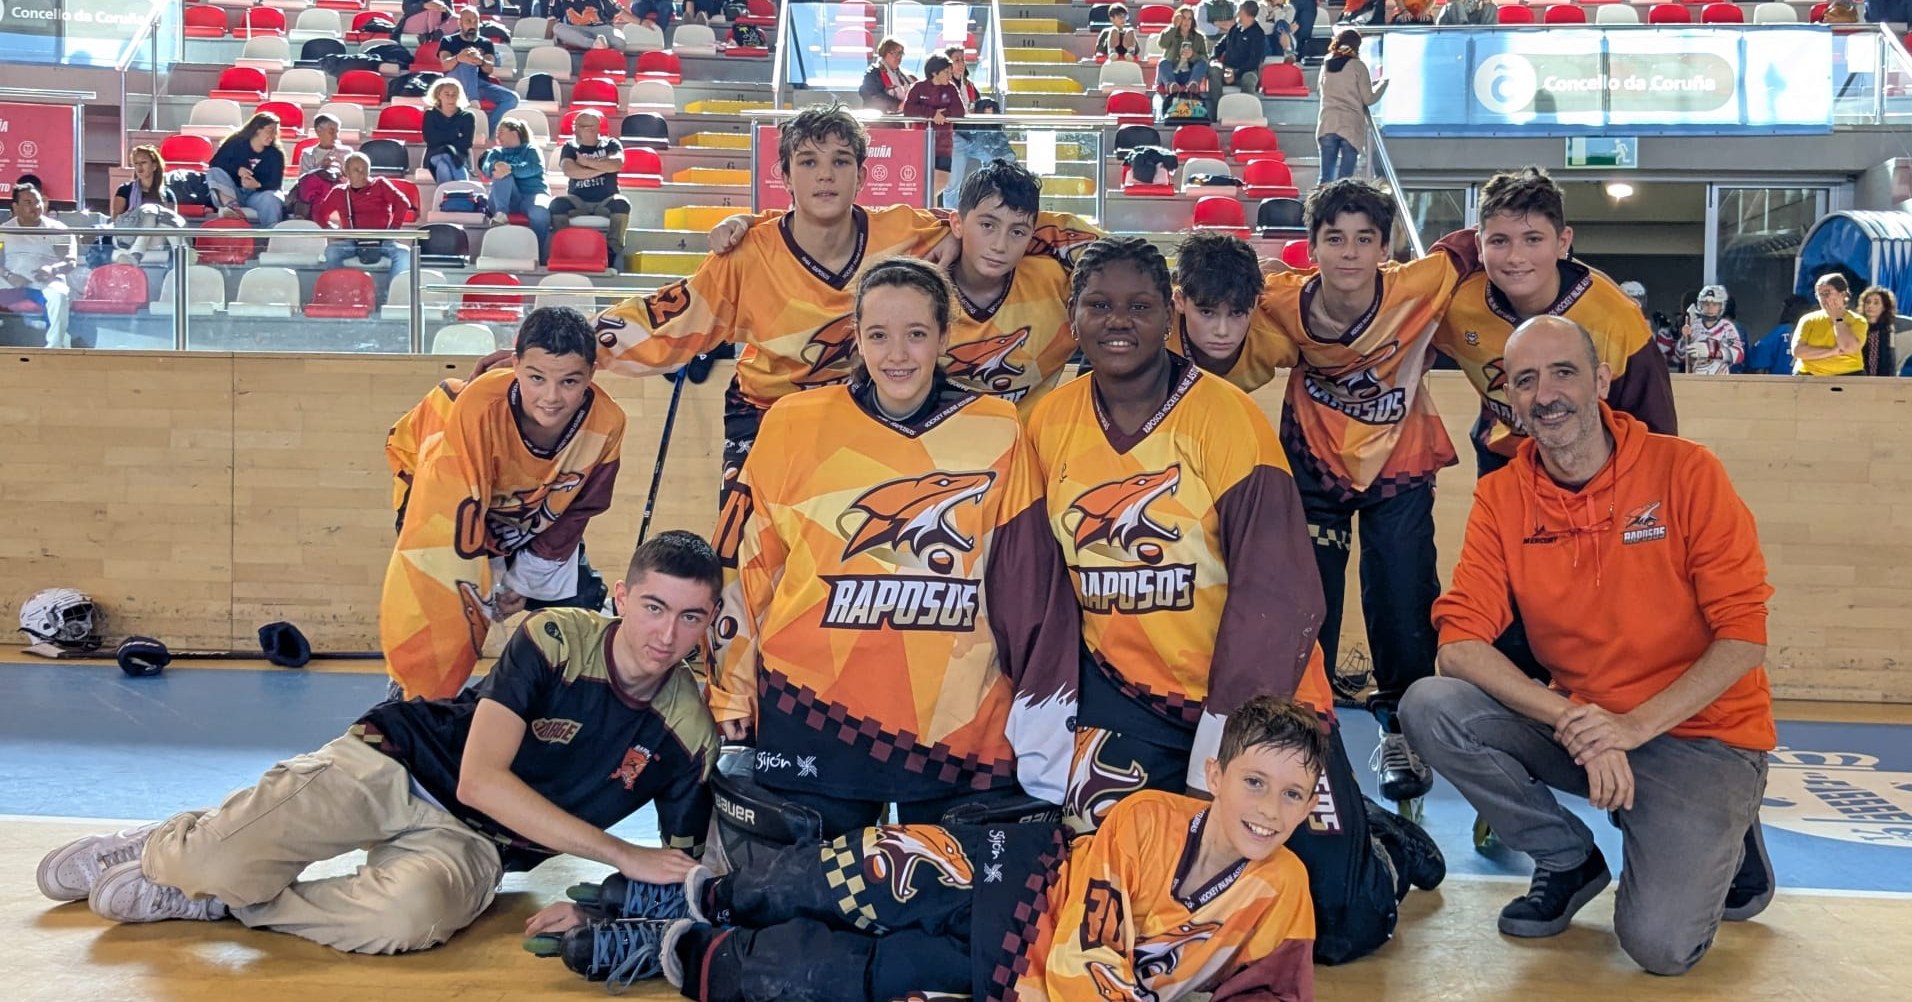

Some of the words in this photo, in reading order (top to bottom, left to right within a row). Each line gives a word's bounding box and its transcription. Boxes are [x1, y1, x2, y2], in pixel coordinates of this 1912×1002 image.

[12, 6, 69, 21] Concello
[74, 10, 92, 23] da
[1543, 74, 1620, 91] Concello
[1624, 74, 1646, 91] da
[1651, 74, 1716, 91] Coruña
[1142, 410, 1166, 434] RAPOSOS
[1162, 393, 1181, 414] HOCKEY
[1523, 536, 1558, 544] MERCURY
[1623, 527, 1666, 544] RAPOSOS
[827, 580, 977, 627] RAPOSOS
[1199, 887, 1218, 905] HOCKEY
[1217, 876, 1233, 895] INLINE
